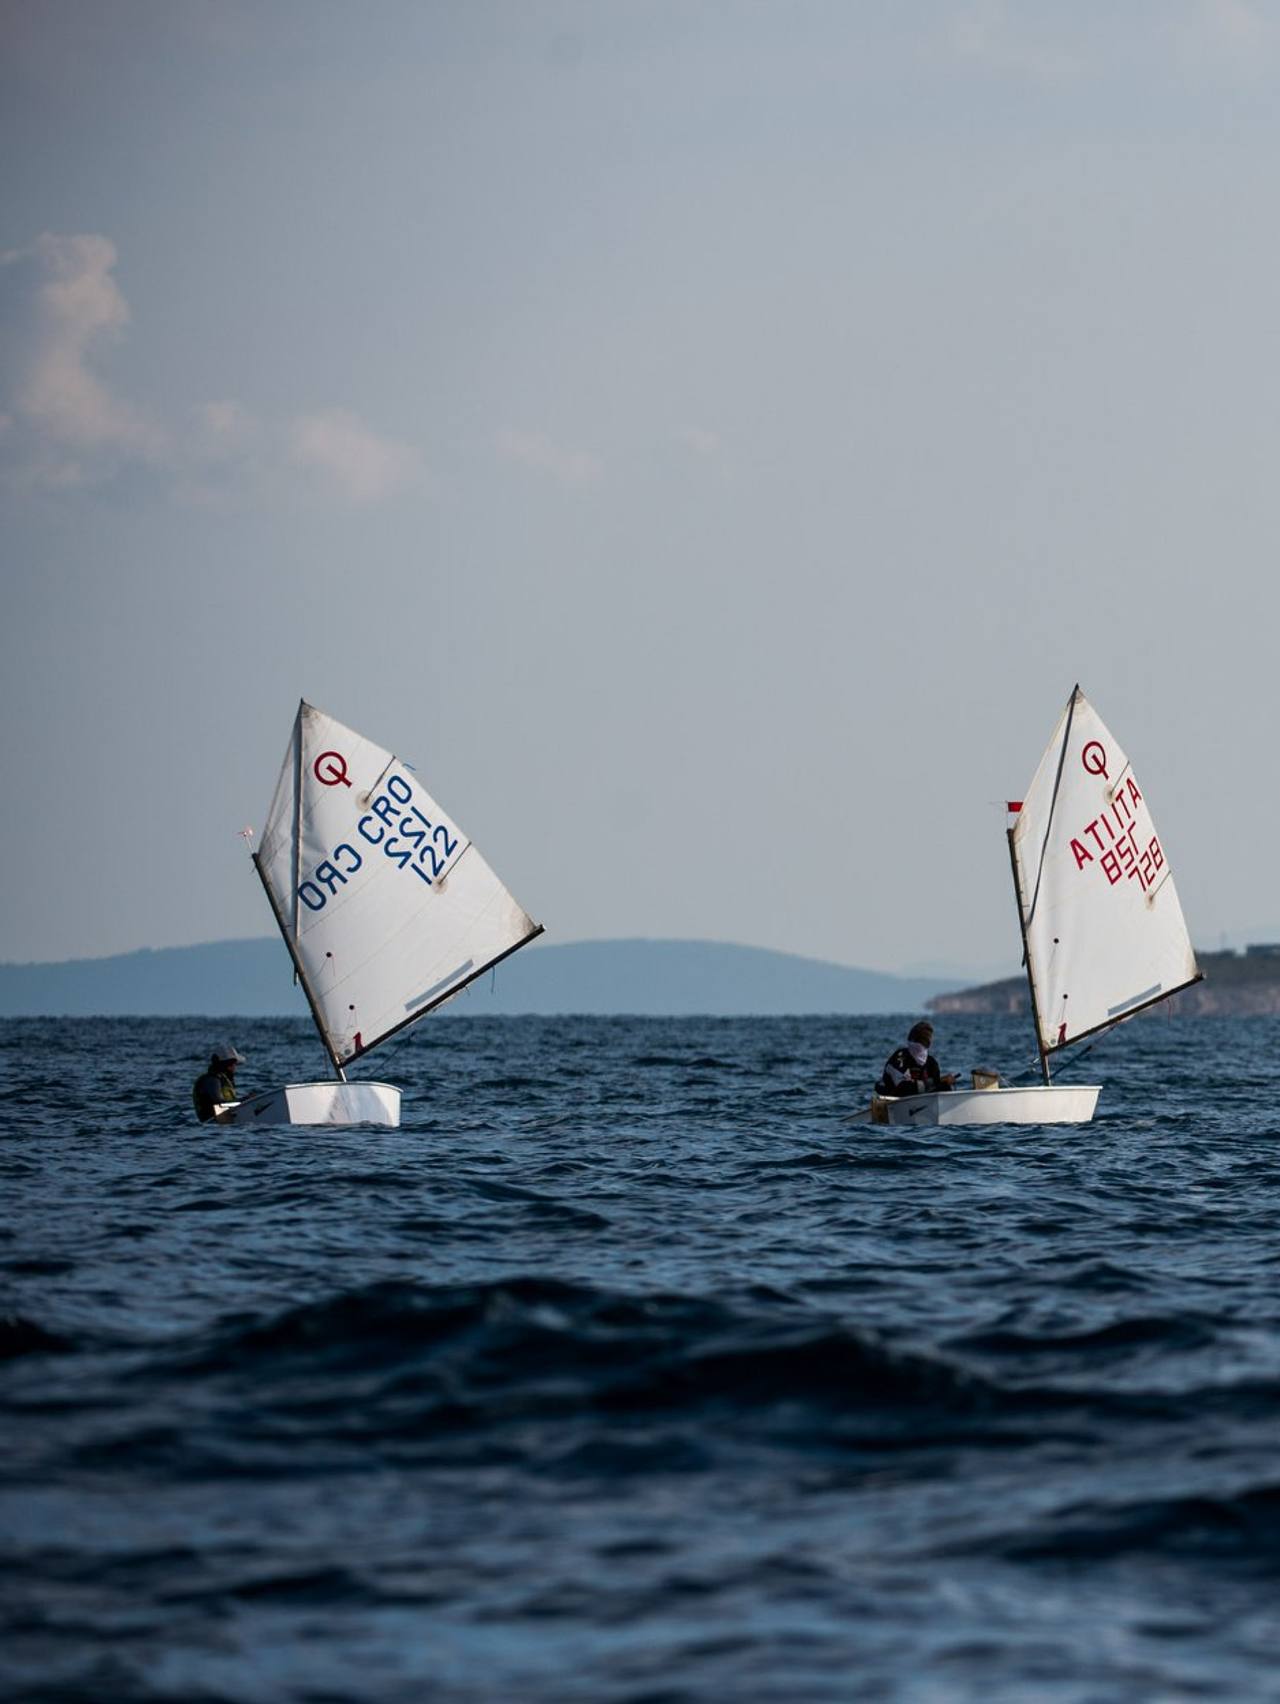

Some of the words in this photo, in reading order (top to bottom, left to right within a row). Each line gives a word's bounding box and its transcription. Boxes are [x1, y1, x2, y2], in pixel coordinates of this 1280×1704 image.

[358, 775, 412, 845] CRO
[1111, 777, 1142, 829] ITA
[411, 825, 459, 886] 122
[1128, 835, 1164, 892] 728
